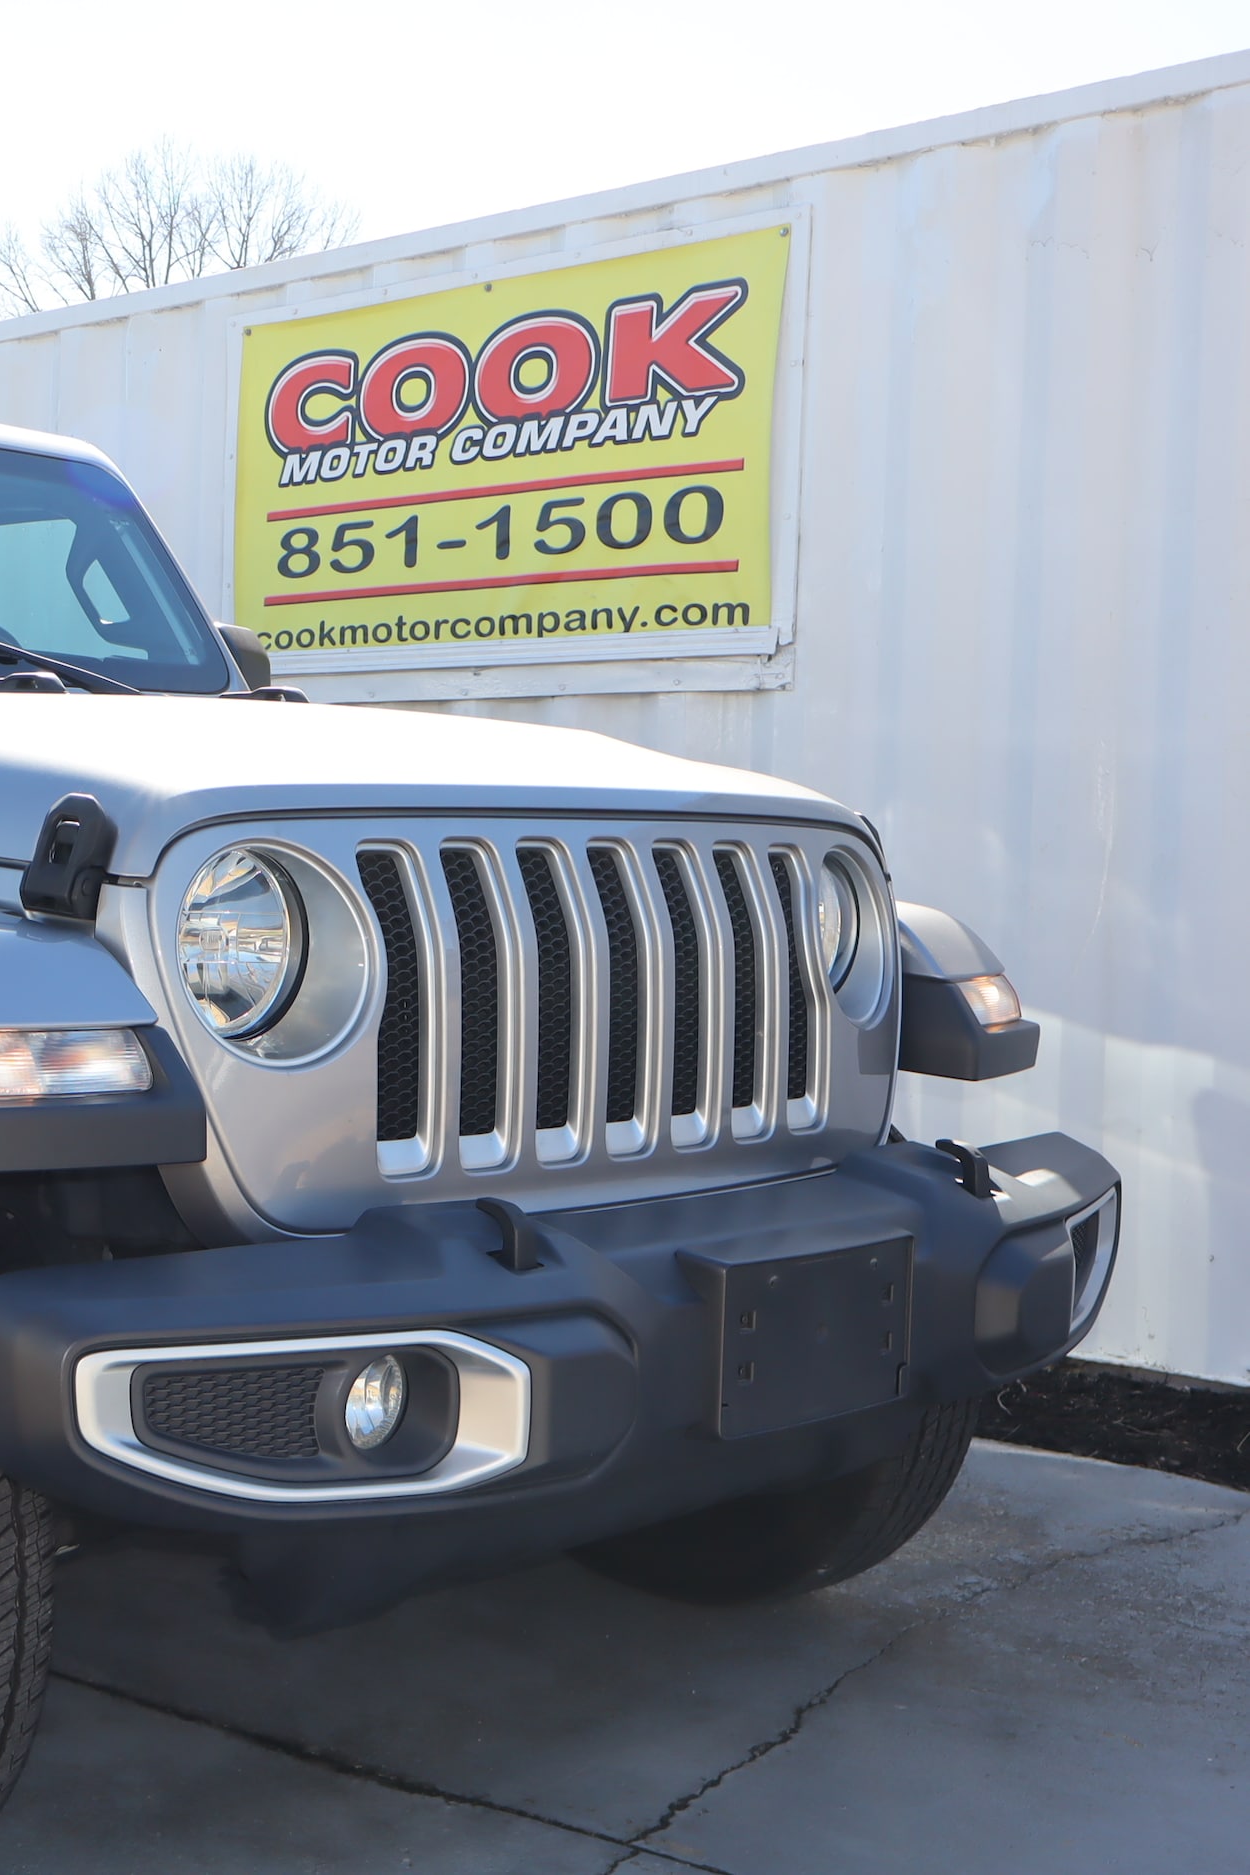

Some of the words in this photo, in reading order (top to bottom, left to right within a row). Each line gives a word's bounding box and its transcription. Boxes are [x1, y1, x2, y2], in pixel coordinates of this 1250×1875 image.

[266, 277, 749, 454] COOK
[278, 433, 439, 487] MOTOR
[449, 395, 720, 464] COMPANY
[276, 484, 725, 579] 851-1500
[257, 601, 751, 651] cookmotorcompany.com
